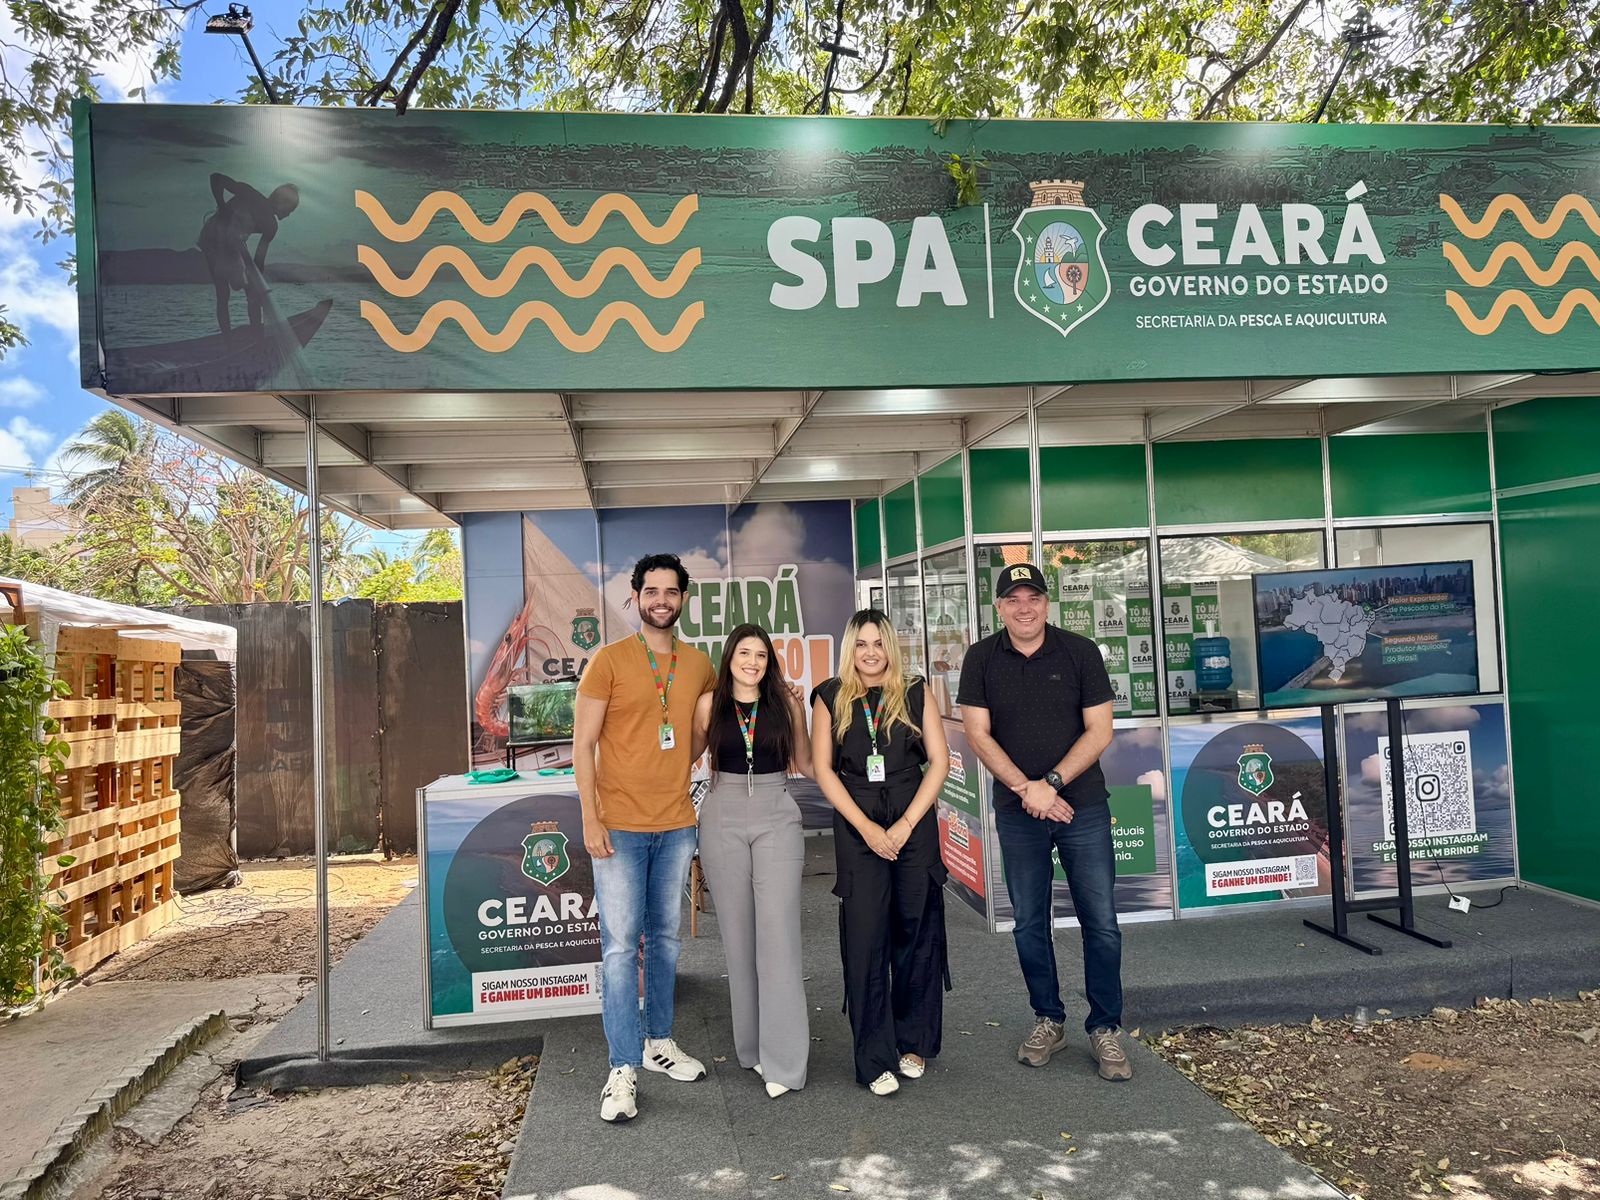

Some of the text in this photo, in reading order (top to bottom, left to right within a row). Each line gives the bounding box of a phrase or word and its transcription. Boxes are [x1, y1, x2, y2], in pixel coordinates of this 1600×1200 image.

[1126, 180, 1386, 267] CEARÁ
[766, 215, 967, 310] SPA
[1129, 273, 1388, 297] GOVERNO DO ESTADO
[1136, 312, 1387, 328] SECRETARIA DA PESCA E AQUICULTURA
[680, 568, 800, 638] CEARÁ
[1098, 618, 1124, 627] CEARÁ
[1207, 791, 1309, 828] CEARÁ
[1208, 822, 1310, 839] GOVERNO DO ESTADO
[1125, 838, 1144, 847] uso
[1373, 841, 1396, 851] SIGA
[1433, 833, 1488, 846] INSTAGRAM
[1384, 845, 1479, 861] E GHE UM BRINDE
[1212, 864, 1290, 879] SIGAM NOSSO INSTAGRAM
[1212, 879, 1217, 888] E
[1218, 876, 1245, 887] GANHE
[1246, 875, 1258, 885] UM
[478, 926, 541, 940] GOVERNO
[545, 924, 564, 935] DO
[480, 944, 523, 954] SECRETARIA
[535, 941, 558, 949] PESCA
[481, 973, 588, 991] SIGAM NOSSO INSTAGRAM
[480, 992, 487, 1004] E
[488, 989, 525, 1003] GANHE
[526, 987, 543, 999] UM
